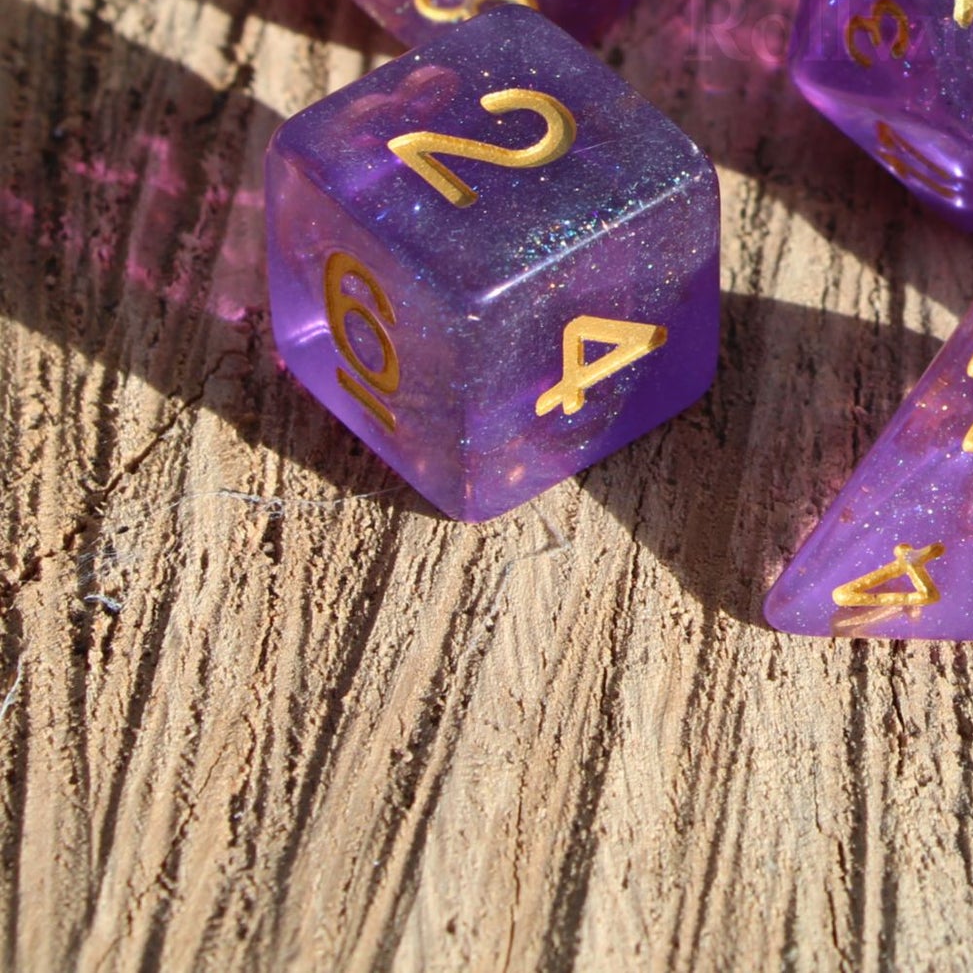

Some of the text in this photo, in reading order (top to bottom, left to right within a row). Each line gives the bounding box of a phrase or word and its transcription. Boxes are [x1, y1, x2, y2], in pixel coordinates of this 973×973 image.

[387, 88, 577, 208] 2
[535, 315, 668, 416] 4
[832, 542, 946, 607] 4
